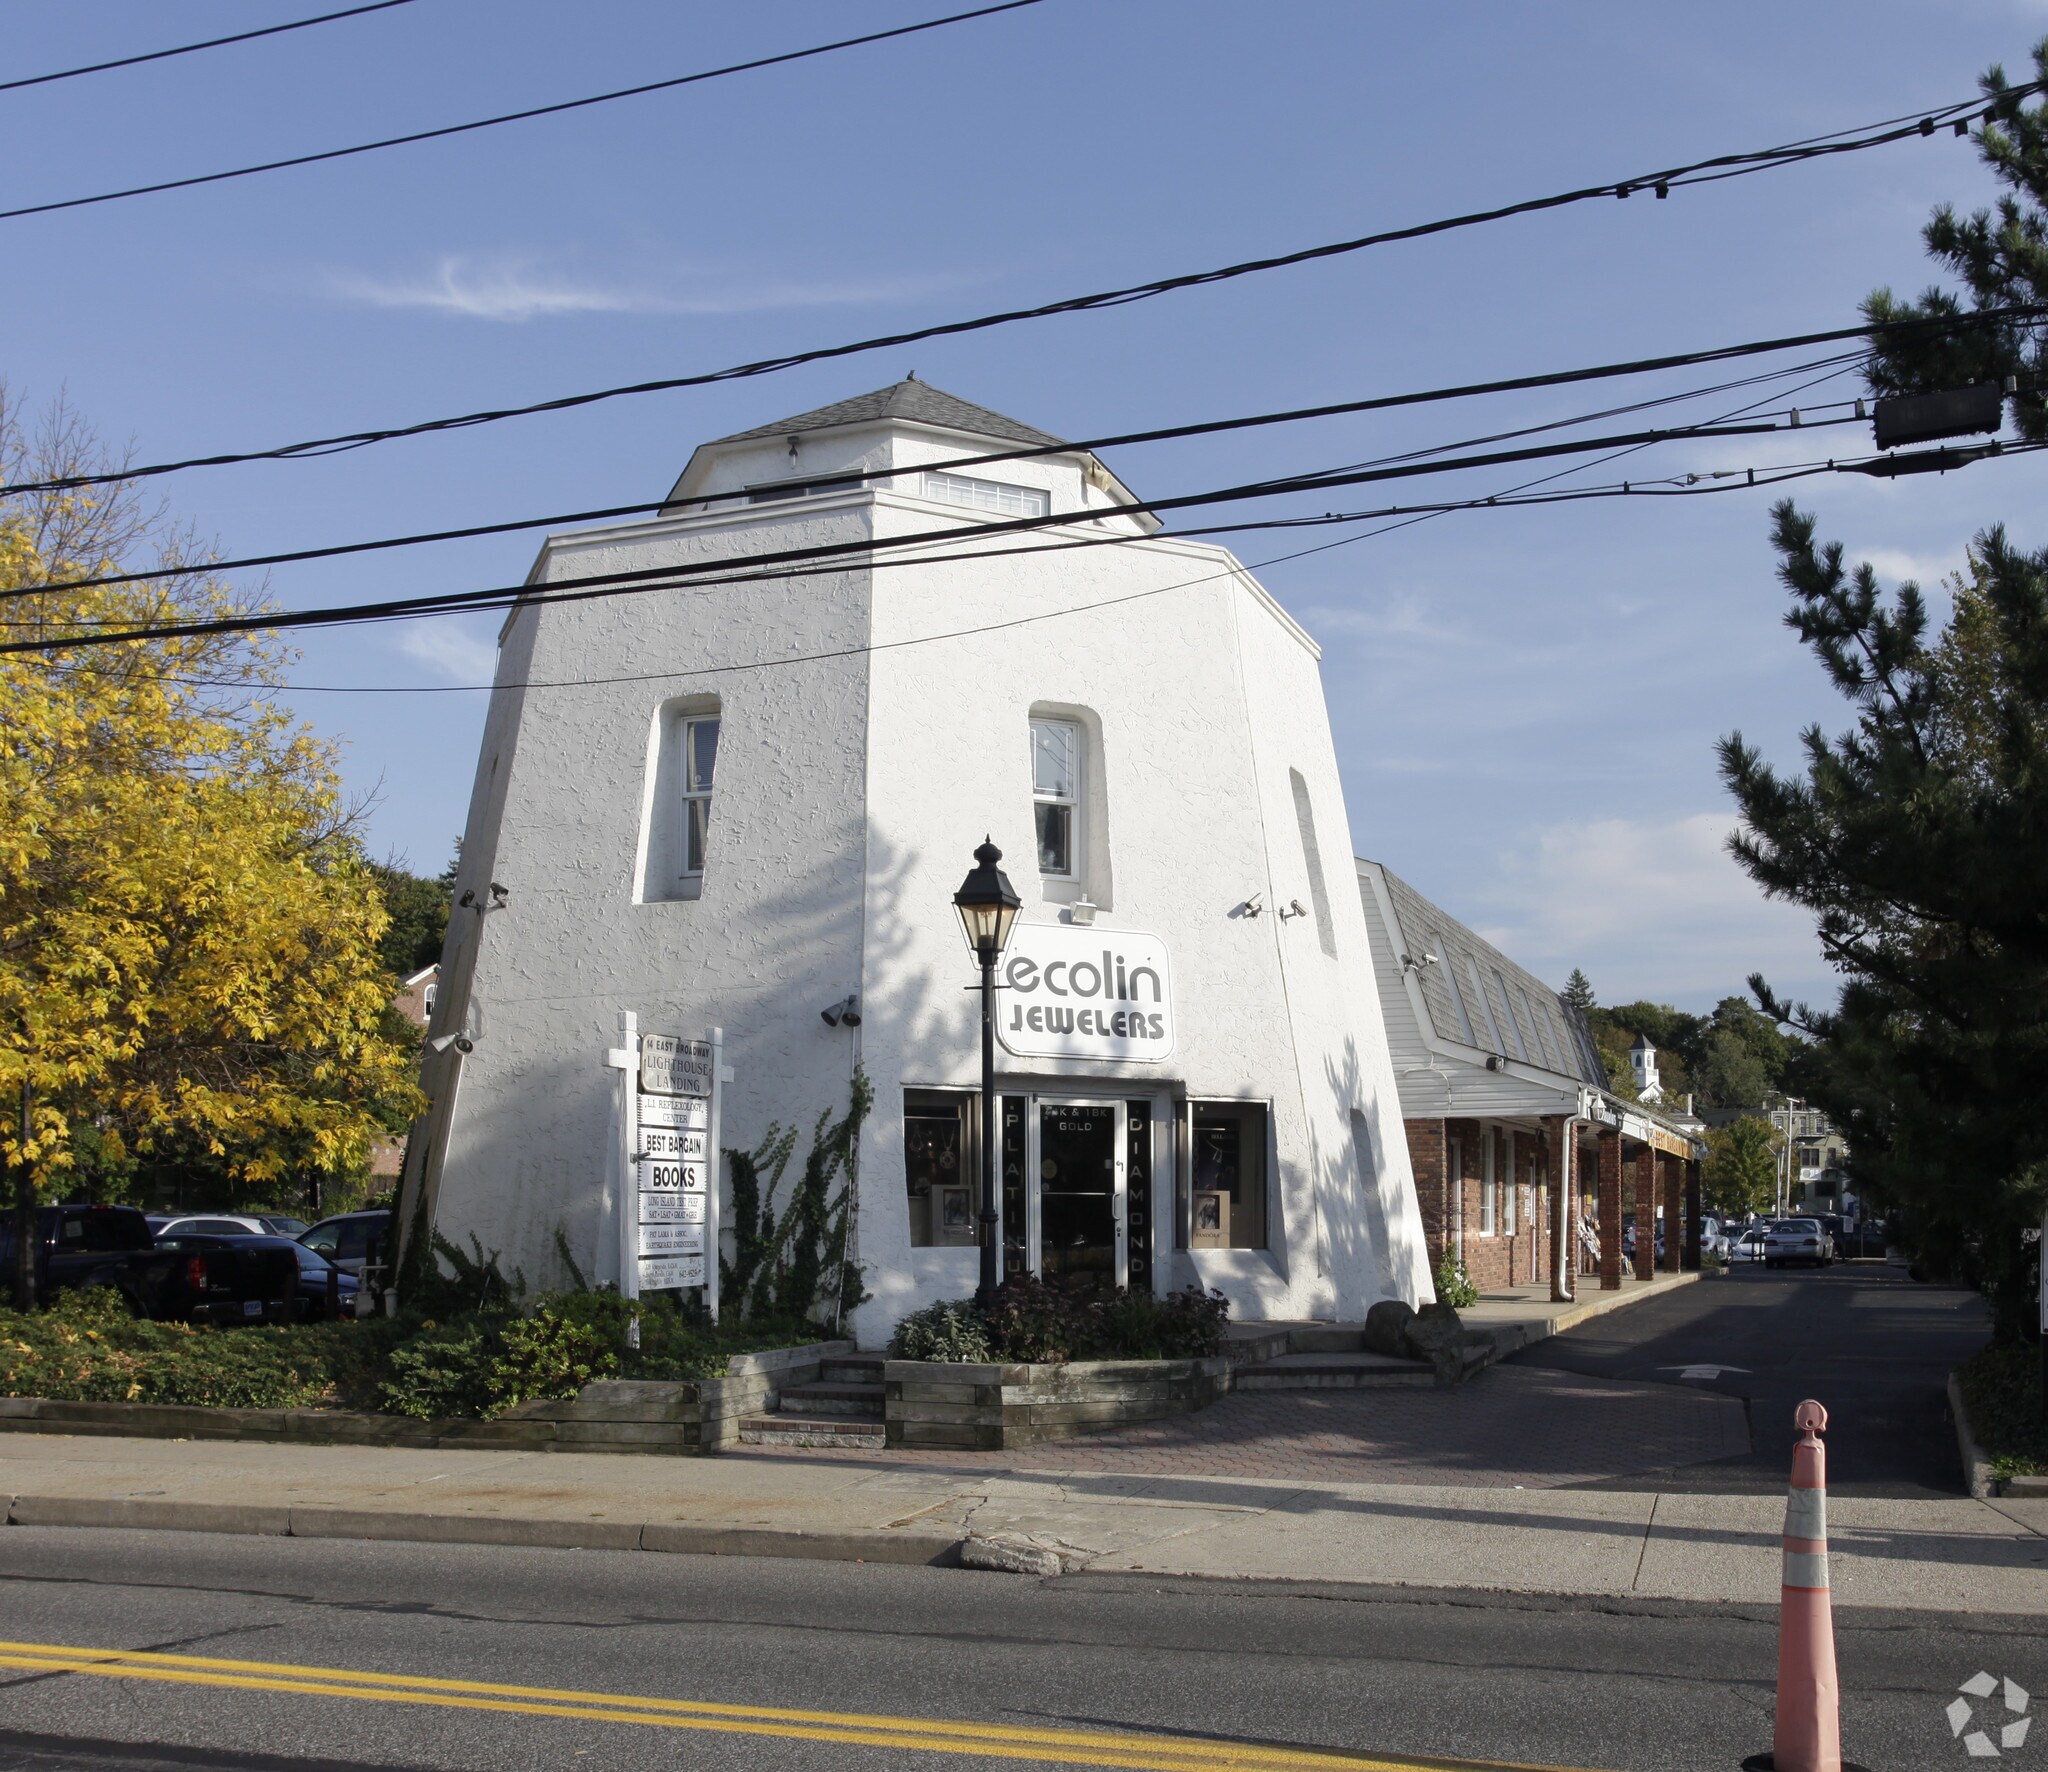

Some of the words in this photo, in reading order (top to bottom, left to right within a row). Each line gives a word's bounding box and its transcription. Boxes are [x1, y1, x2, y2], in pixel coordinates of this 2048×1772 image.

[1006, 950, 1162, 1003] ecolin
[1010, 1004, 1165, 1040] JEWELERS
[646, 1040, 653, 1049] 14
[656, 1041, 673, 1052] EAST
[676, 1043, 710, 1058] BROADWAY
[647, 1056, 708, 1076] LIGHTHOUSE
[656, 1075, 700, 1092] LANDING
[663, 1113, 688, 1124] CENTER
[1071, 1107, 1080, 1117] &
[1059, 1121, 1092, 1132] GOLD
[646, 1134, 666, 1151] BEST
[668, 1136, 701, 1154] BARGAIN
[653, 1166, 695, 1187] BOOKS
[648, 1196, 659, 1206] LONG
[660, 1197, 676, 1207] ISLAND
